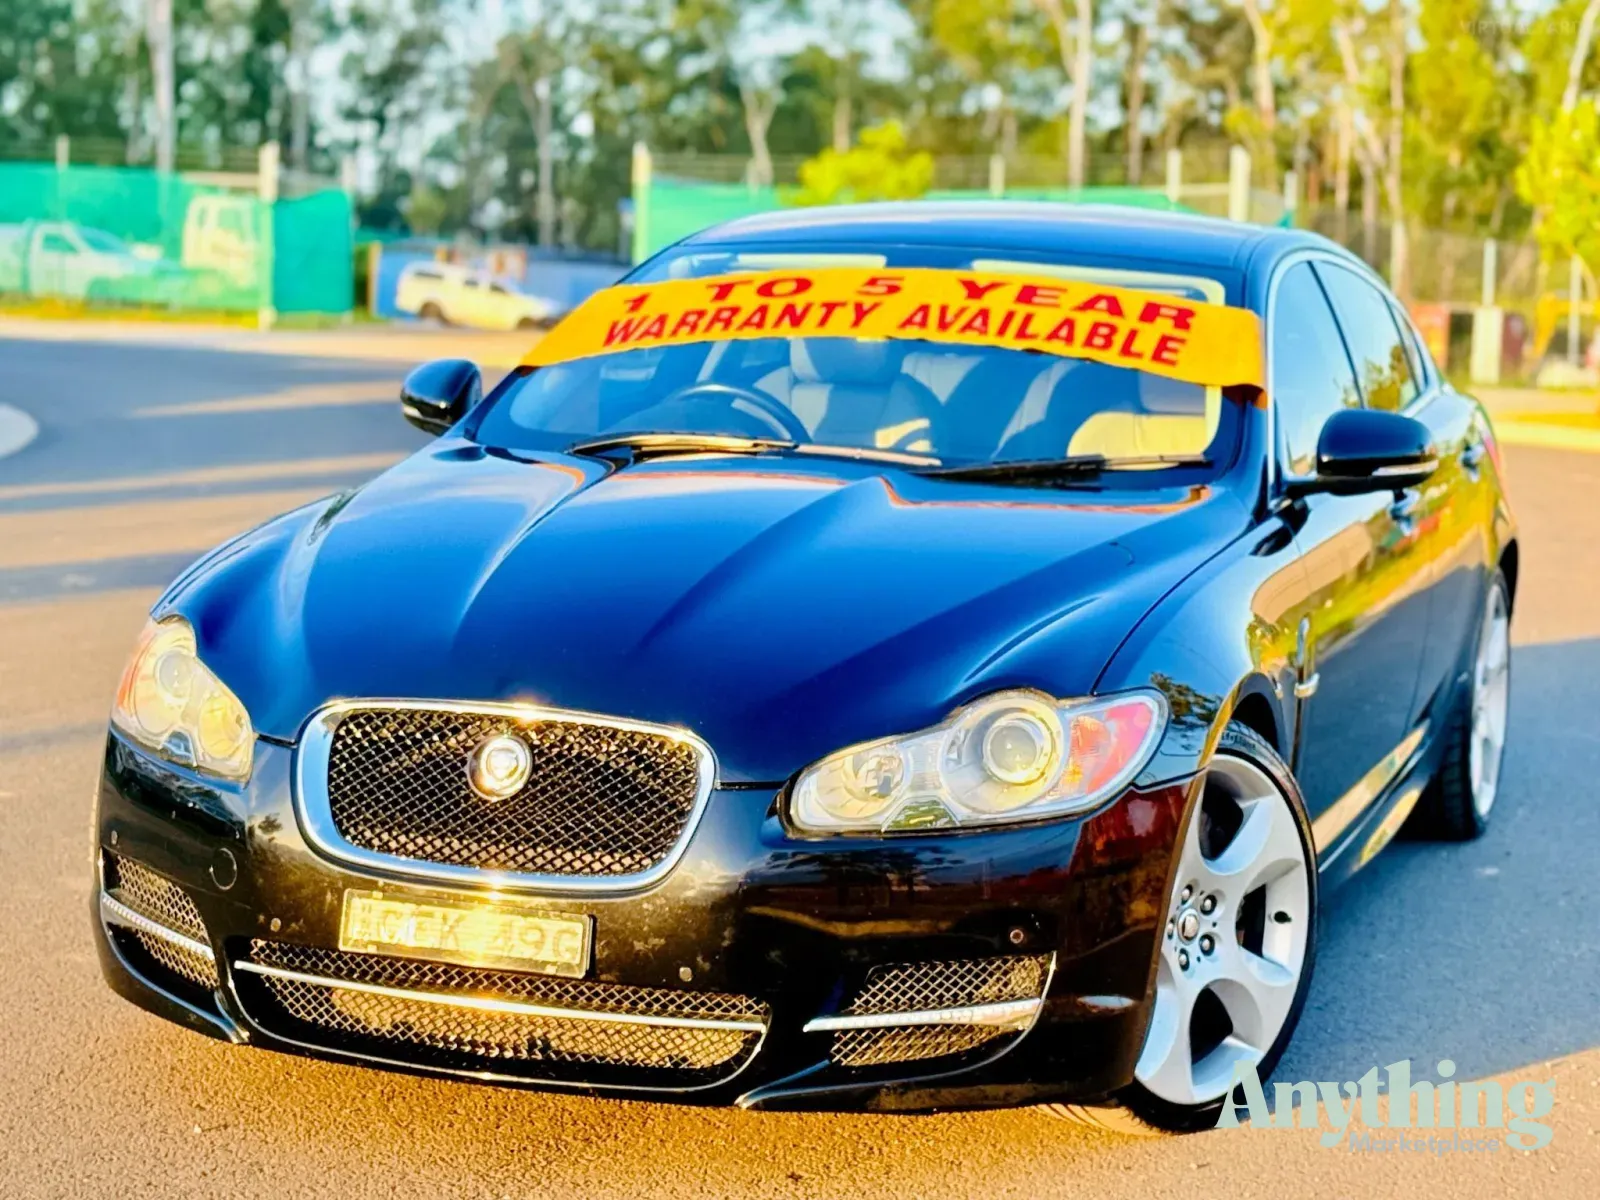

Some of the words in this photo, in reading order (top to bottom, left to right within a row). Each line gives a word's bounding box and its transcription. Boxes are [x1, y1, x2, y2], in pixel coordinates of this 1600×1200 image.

[603, 301, 882, 347] WARRANTY
[897, 303, 1187, 366] AVAILABLE
[624, 292, 651, 314] 1
[705, 277, 813, 303] TO
[856, 276, 906, 297] 5
[957, 278, 1196, 331] YEAR
